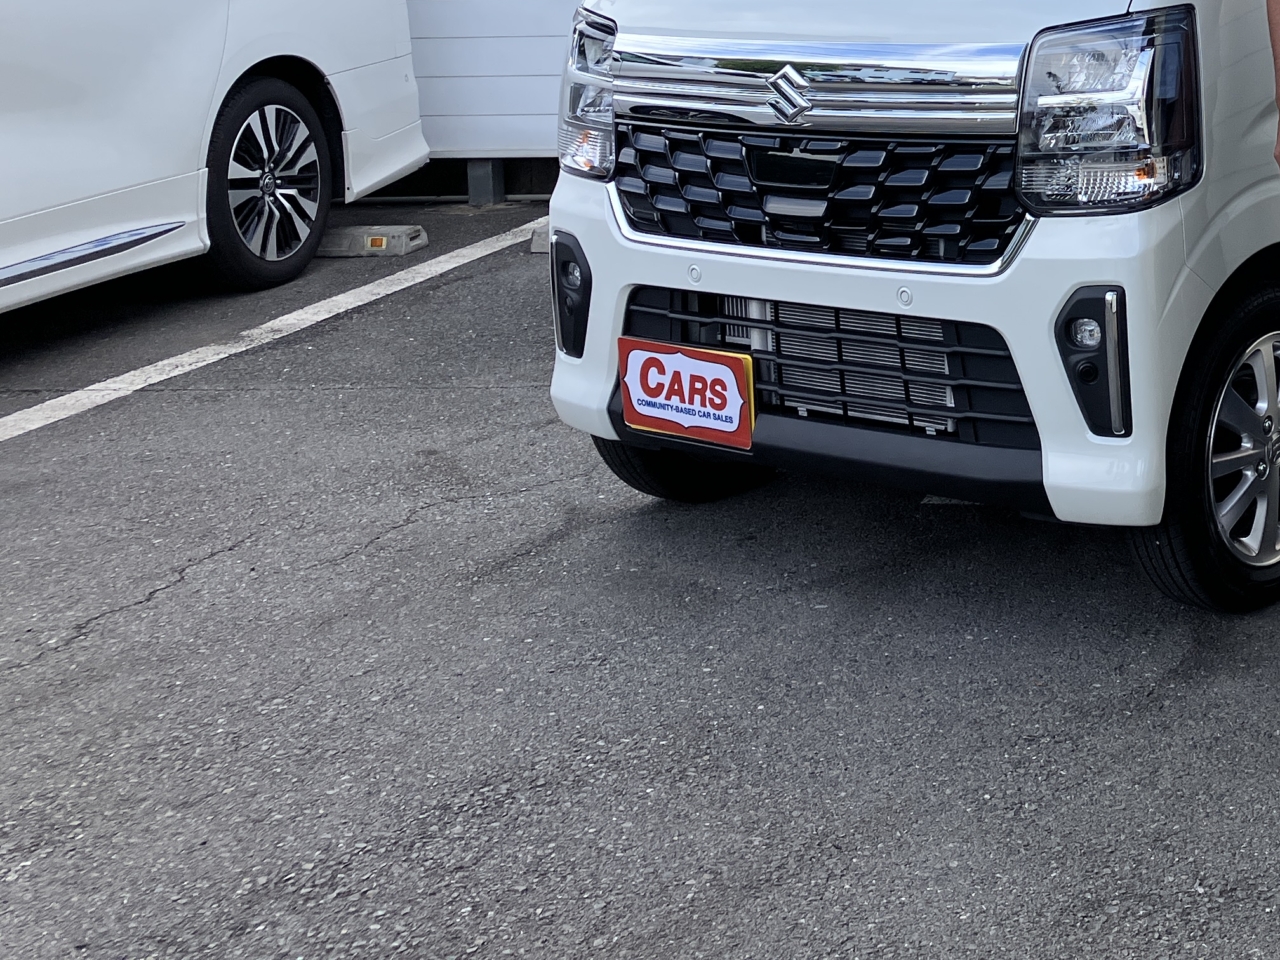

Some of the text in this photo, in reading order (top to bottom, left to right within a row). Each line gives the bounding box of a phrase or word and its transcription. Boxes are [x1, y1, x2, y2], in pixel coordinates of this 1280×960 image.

[639, 356, 728, 411] CARS
[636, 398, 733, 424] COMMUNITY-BASED CAR SALES
